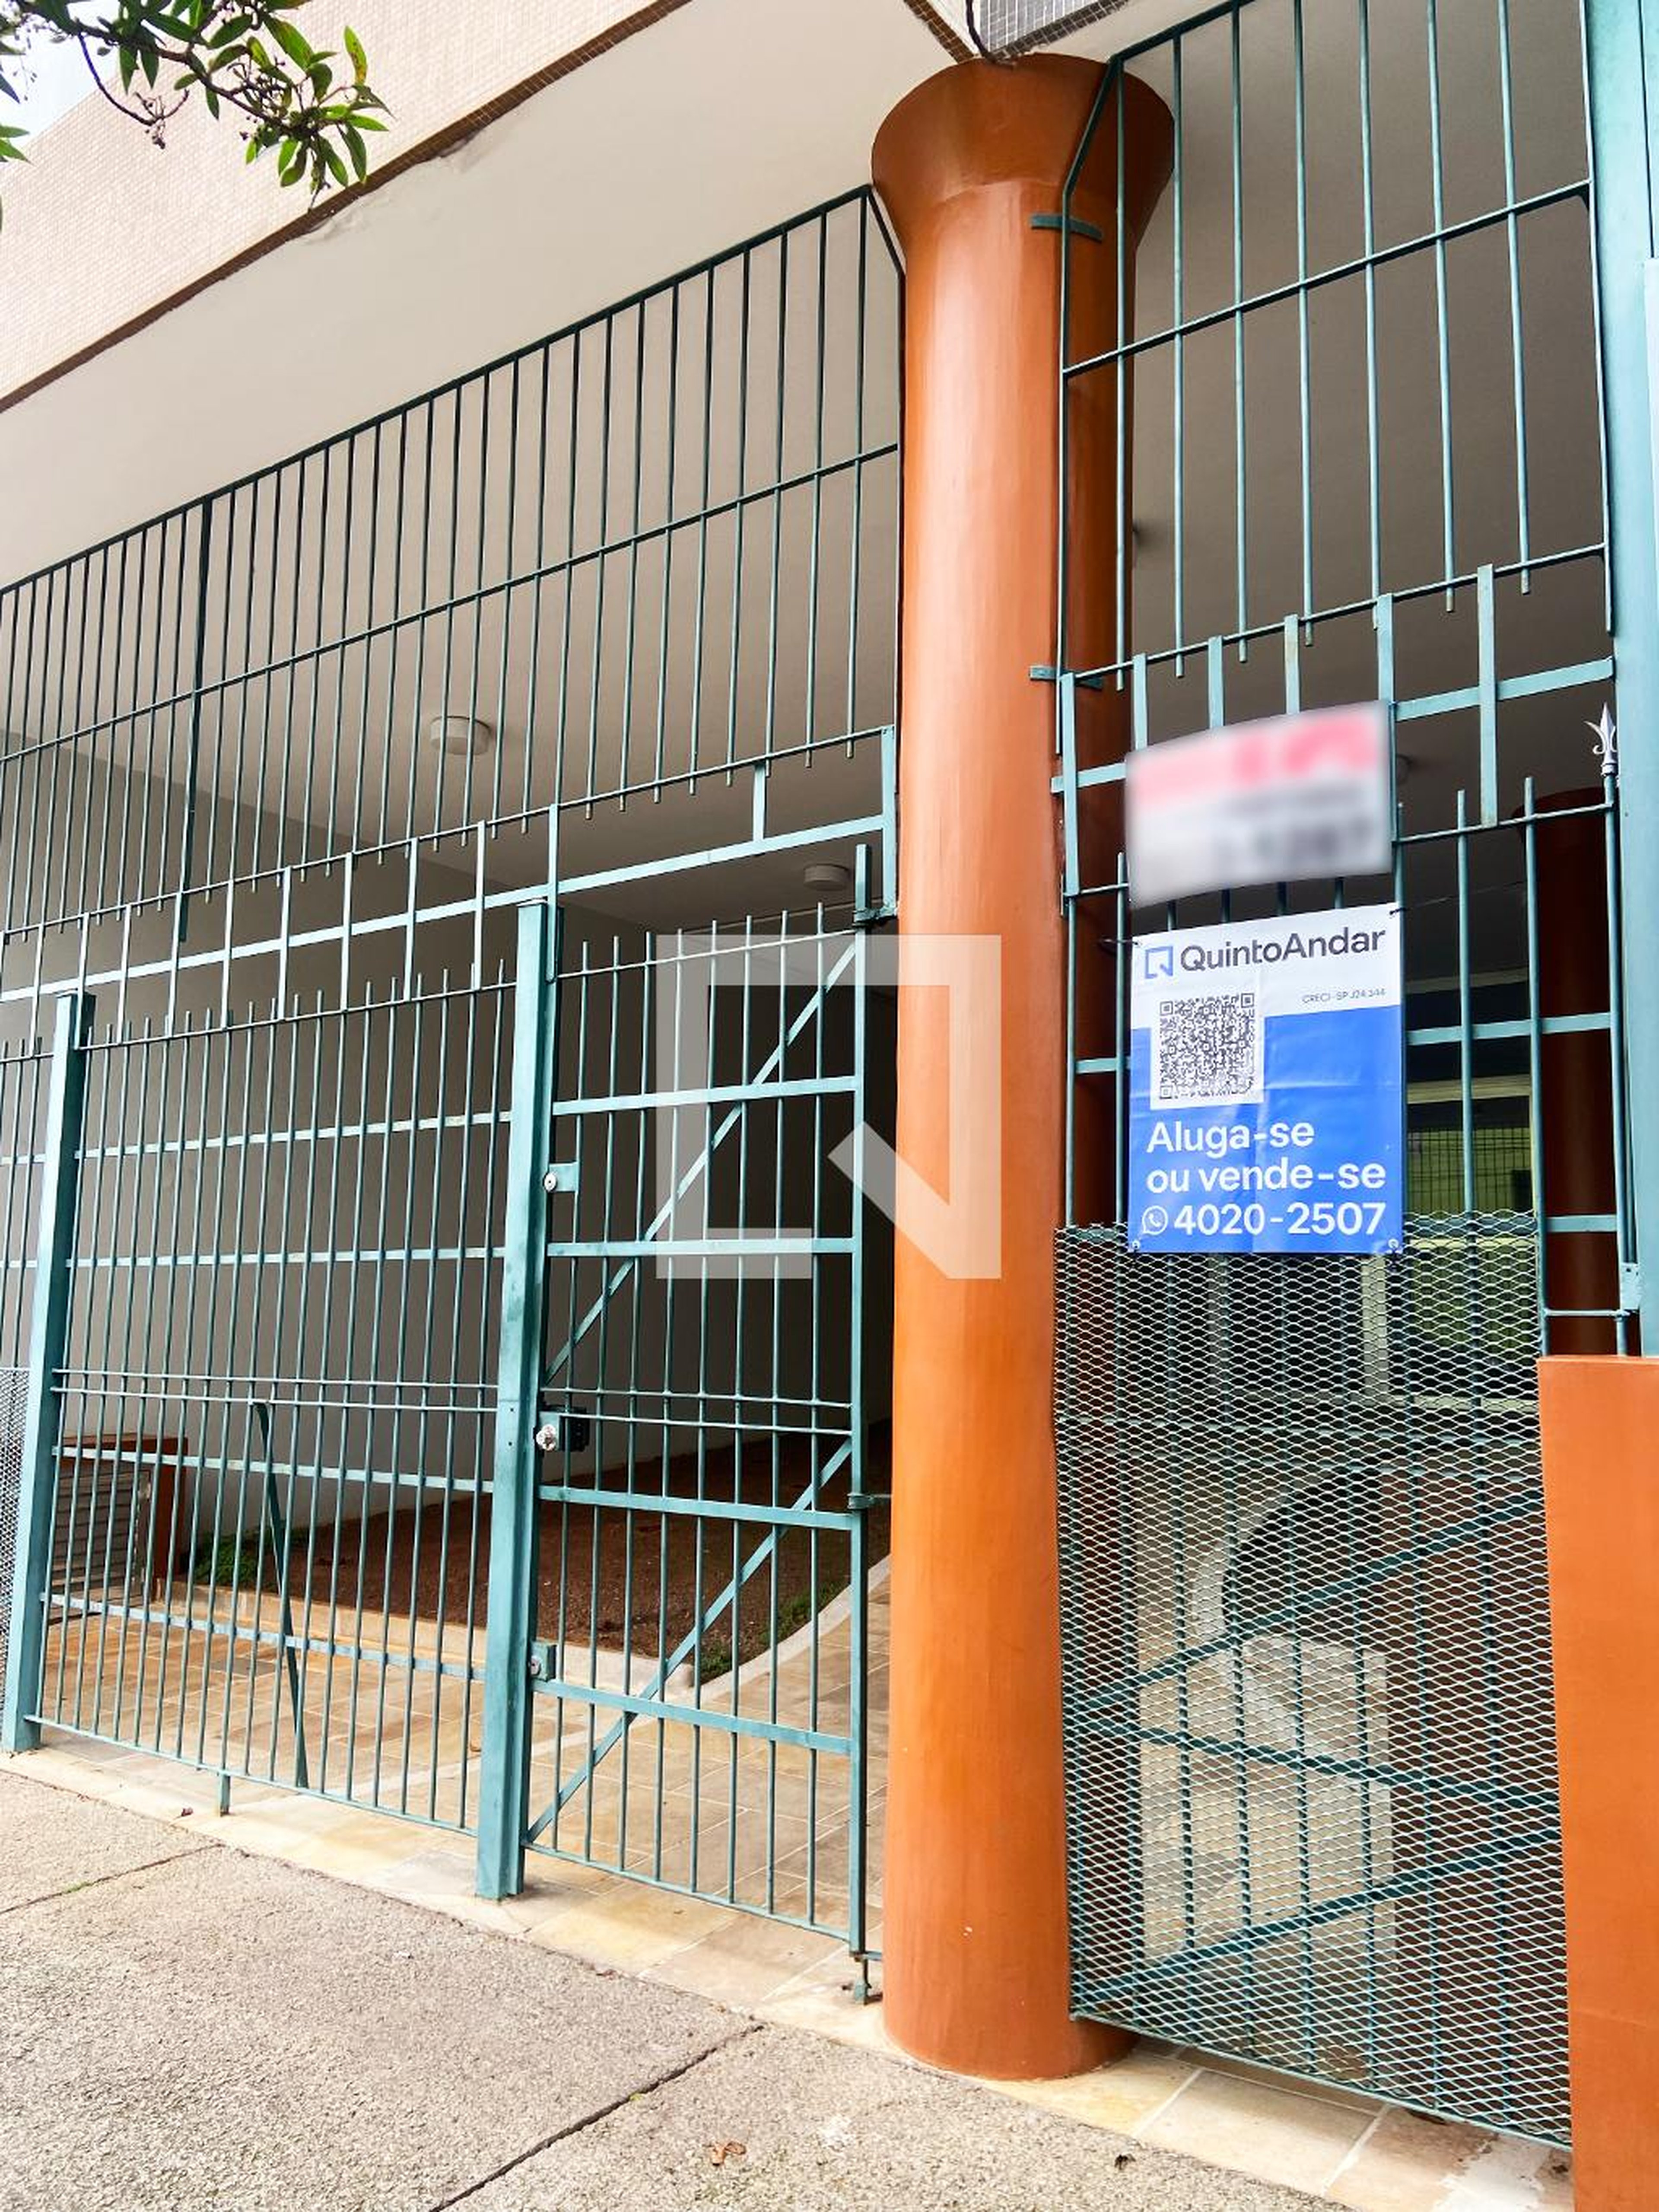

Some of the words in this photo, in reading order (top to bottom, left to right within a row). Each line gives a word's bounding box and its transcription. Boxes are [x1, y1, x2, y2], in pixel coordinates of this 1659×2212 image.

[1180, 927, 1386, 971] QuintoAndar
[1146, 1120, 1315, 1159] Aluga-se
[1146, 1168, 1189, 1194] ou
[1198, 1157, 1386, 1191] vende-se
[1173, 1202, 1386, 1235] 4020-2507
